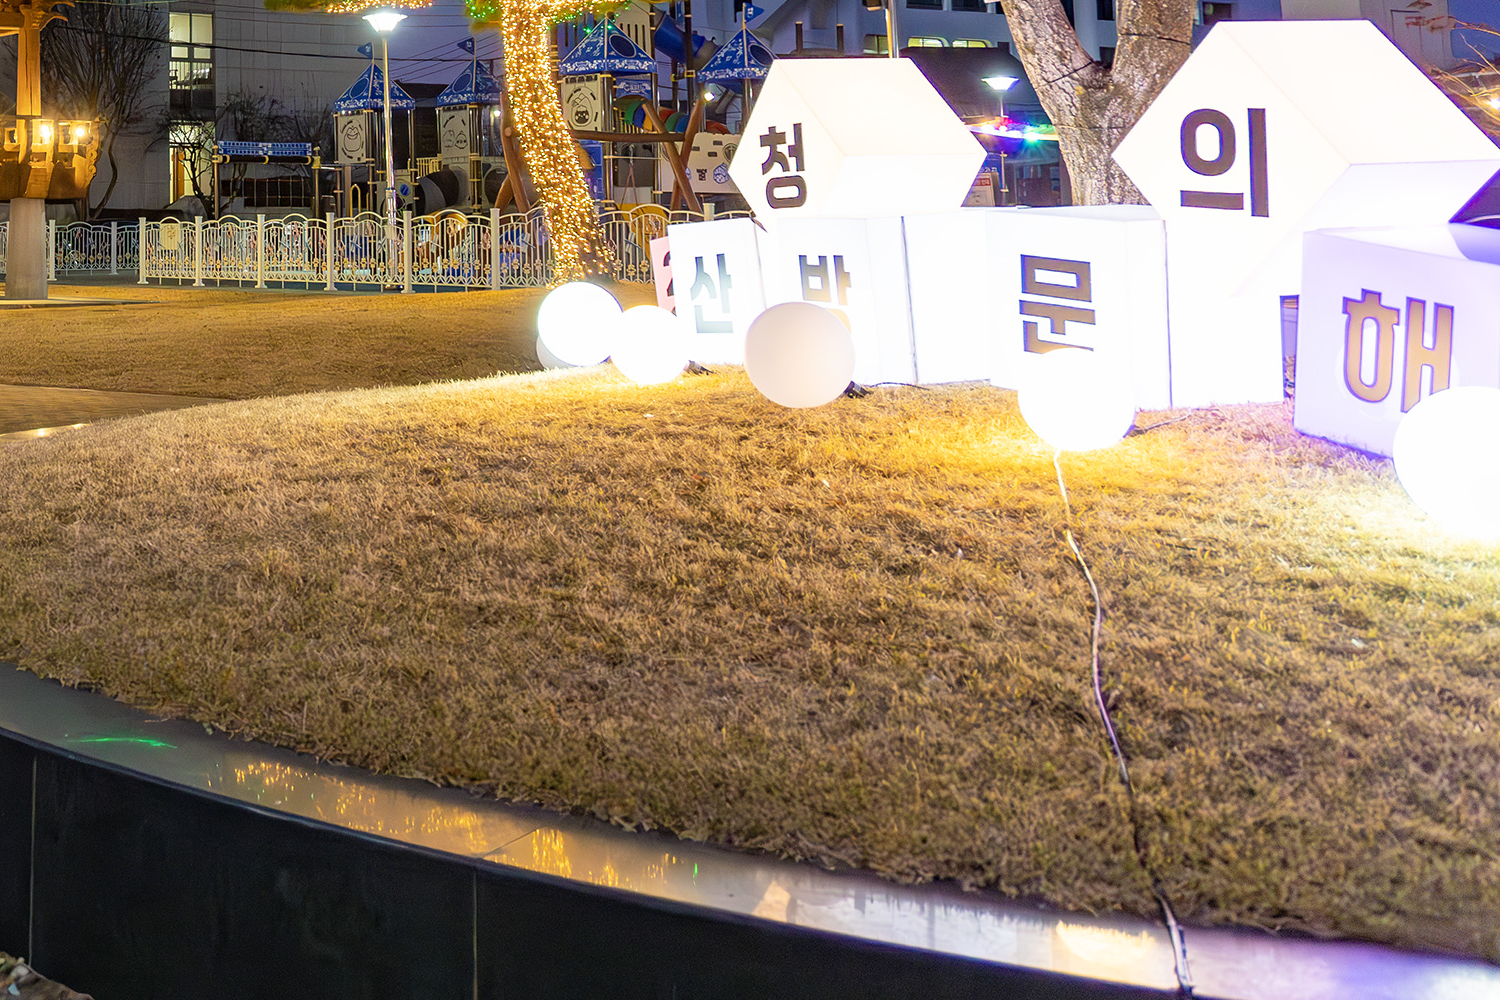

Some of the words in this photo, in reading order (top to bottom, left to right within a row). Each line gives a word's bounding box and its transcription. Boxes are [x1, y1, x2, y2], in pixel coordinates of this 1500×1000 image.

[759, 123, 807, 209] 청
[1180, 108, 1269, 218] 의
[690, 253, 733, 334] 산
[1019, 254, 1096, 354] 문
[1342, 288, 1455, 414] 해
